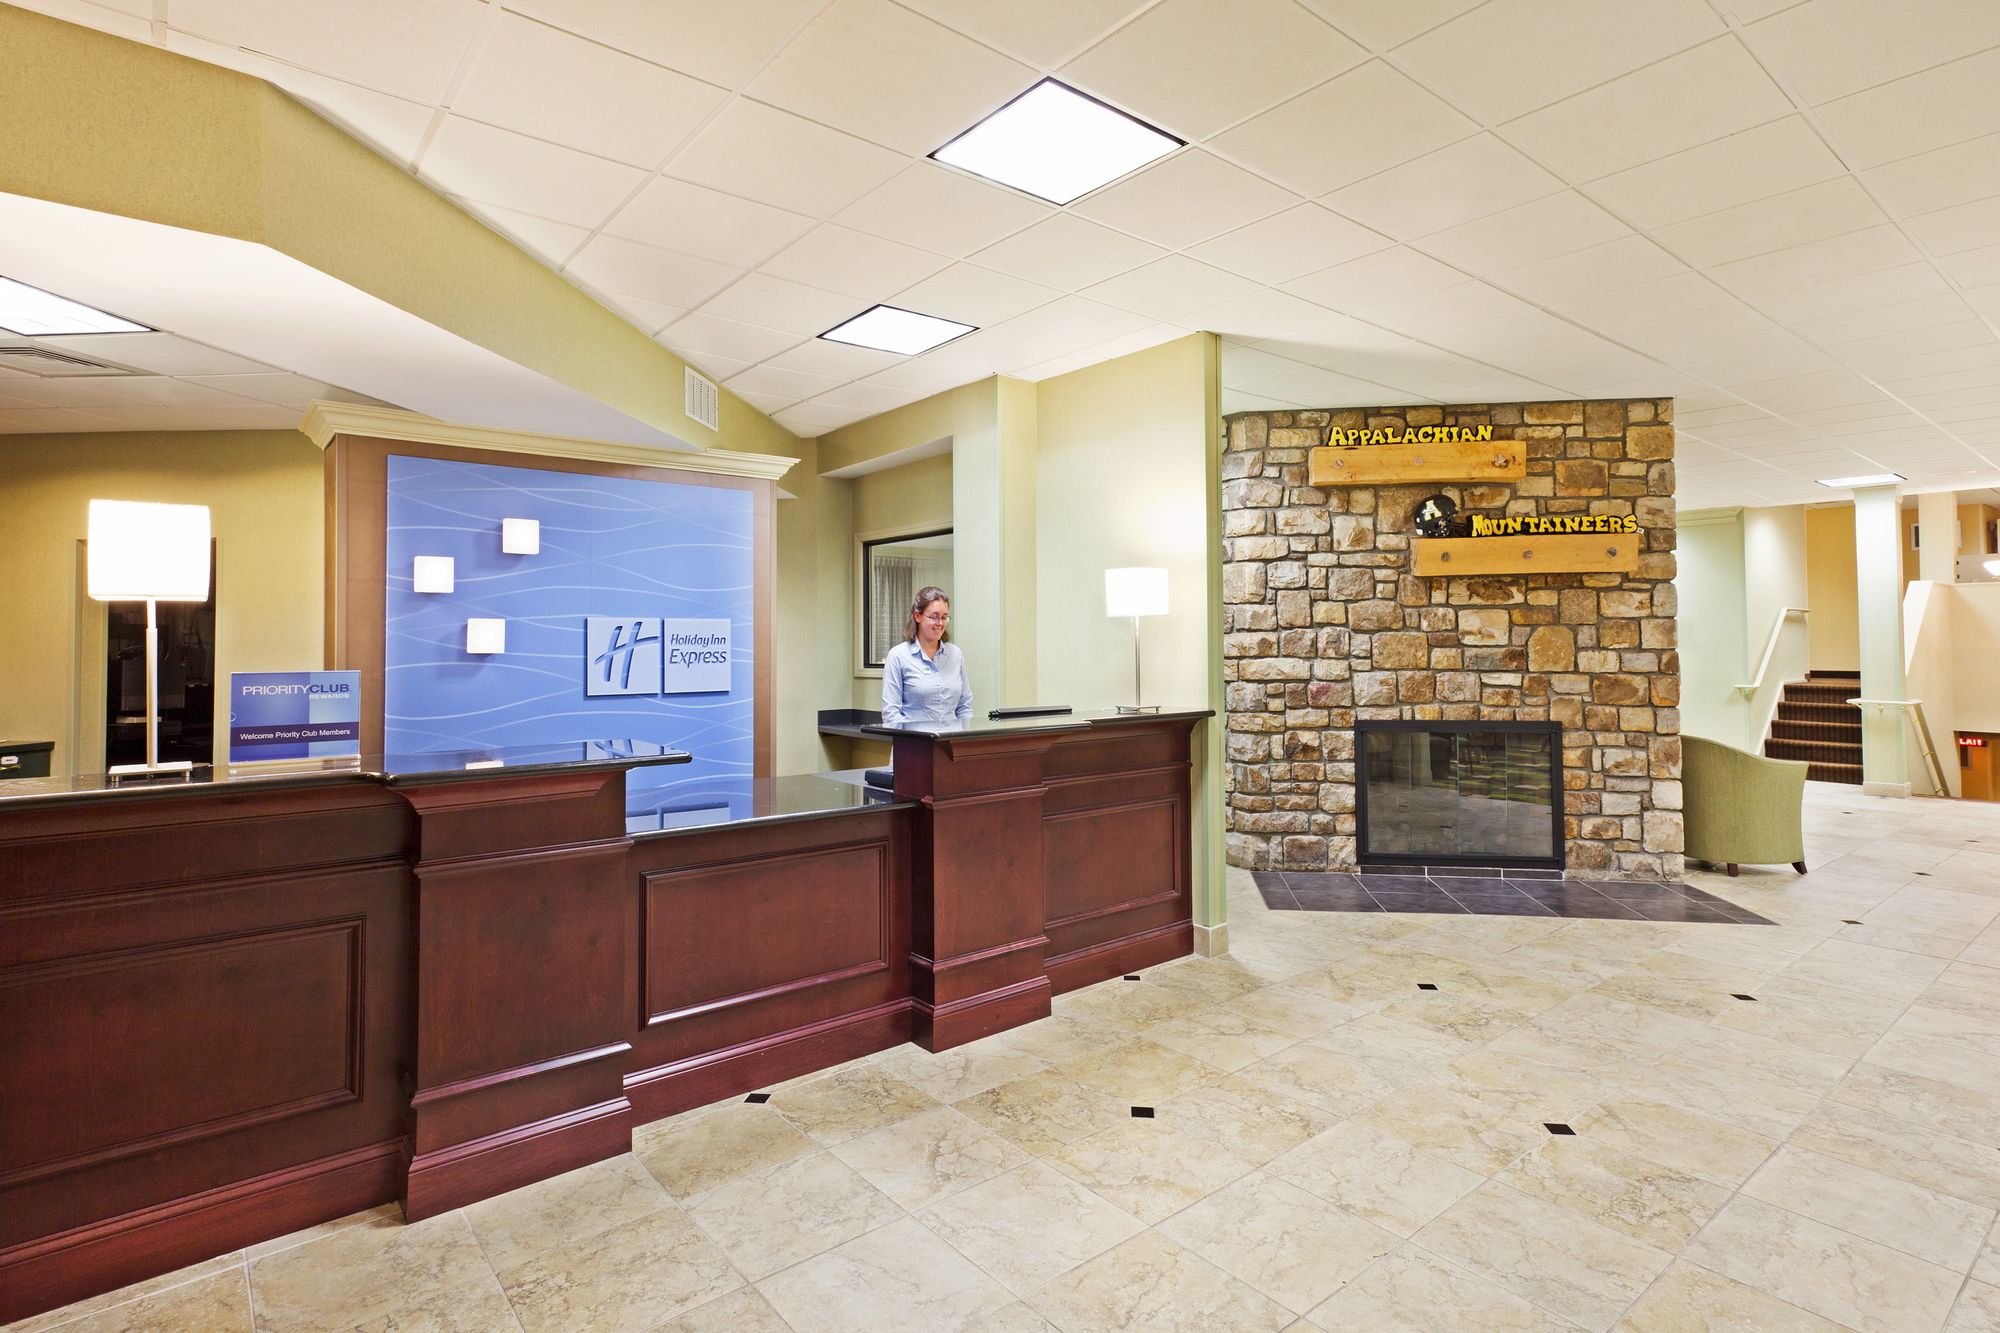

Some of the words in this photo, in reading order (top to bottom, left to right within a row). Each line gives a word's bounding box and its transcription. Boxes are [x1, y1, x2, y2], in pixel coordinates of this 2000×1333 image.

[1327, 424, 1494, 448] APPALACHIAN
[1471, 514, 1638, 537] MOUNTAINEERS
[669, 648, 727, 668] Express
[309, 693, 350, 701] REWARDS
[240, 732, 274, 741] Welcome
[275, 730, 300, 739] Priority
[301, 729, 317, 738] Club
[319, 728, 351, 736] Members
